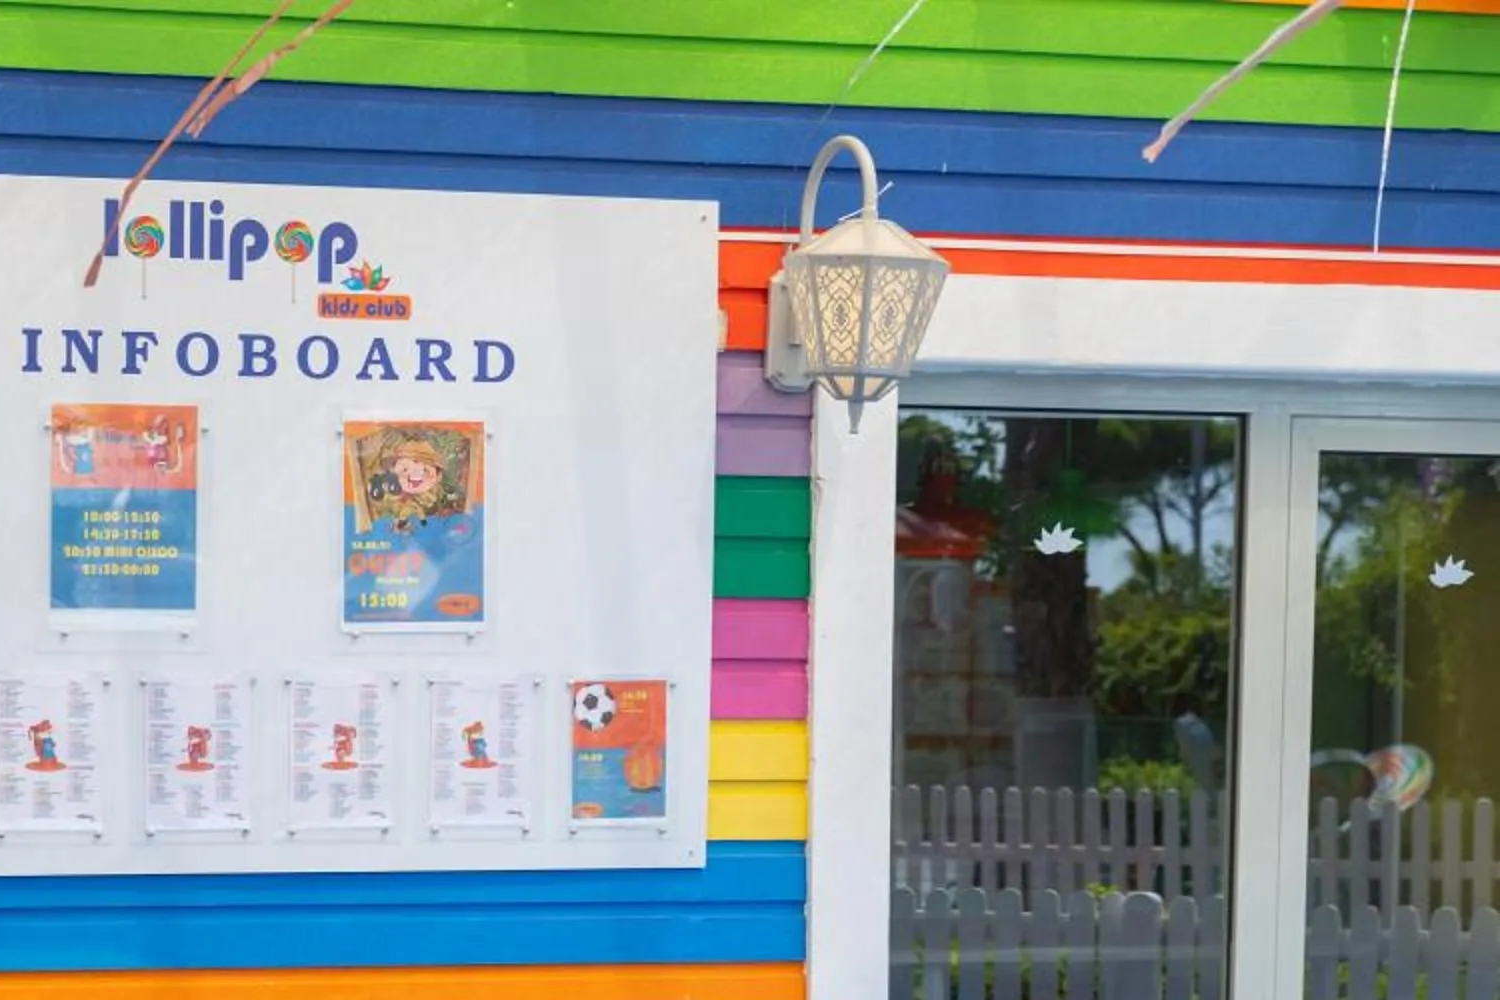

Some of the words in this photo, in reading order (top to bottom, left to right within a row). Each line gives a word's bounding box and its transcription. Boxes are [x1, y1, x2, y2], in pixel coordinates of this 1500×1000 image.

[103, 198, 359, 284] lollipop
[321, 298, 359, 317] kids
[365, 299, 407, 317] club
[21, 328, 517, 384] INFOBOARD
[360, 592, 408, 609] 15:00
